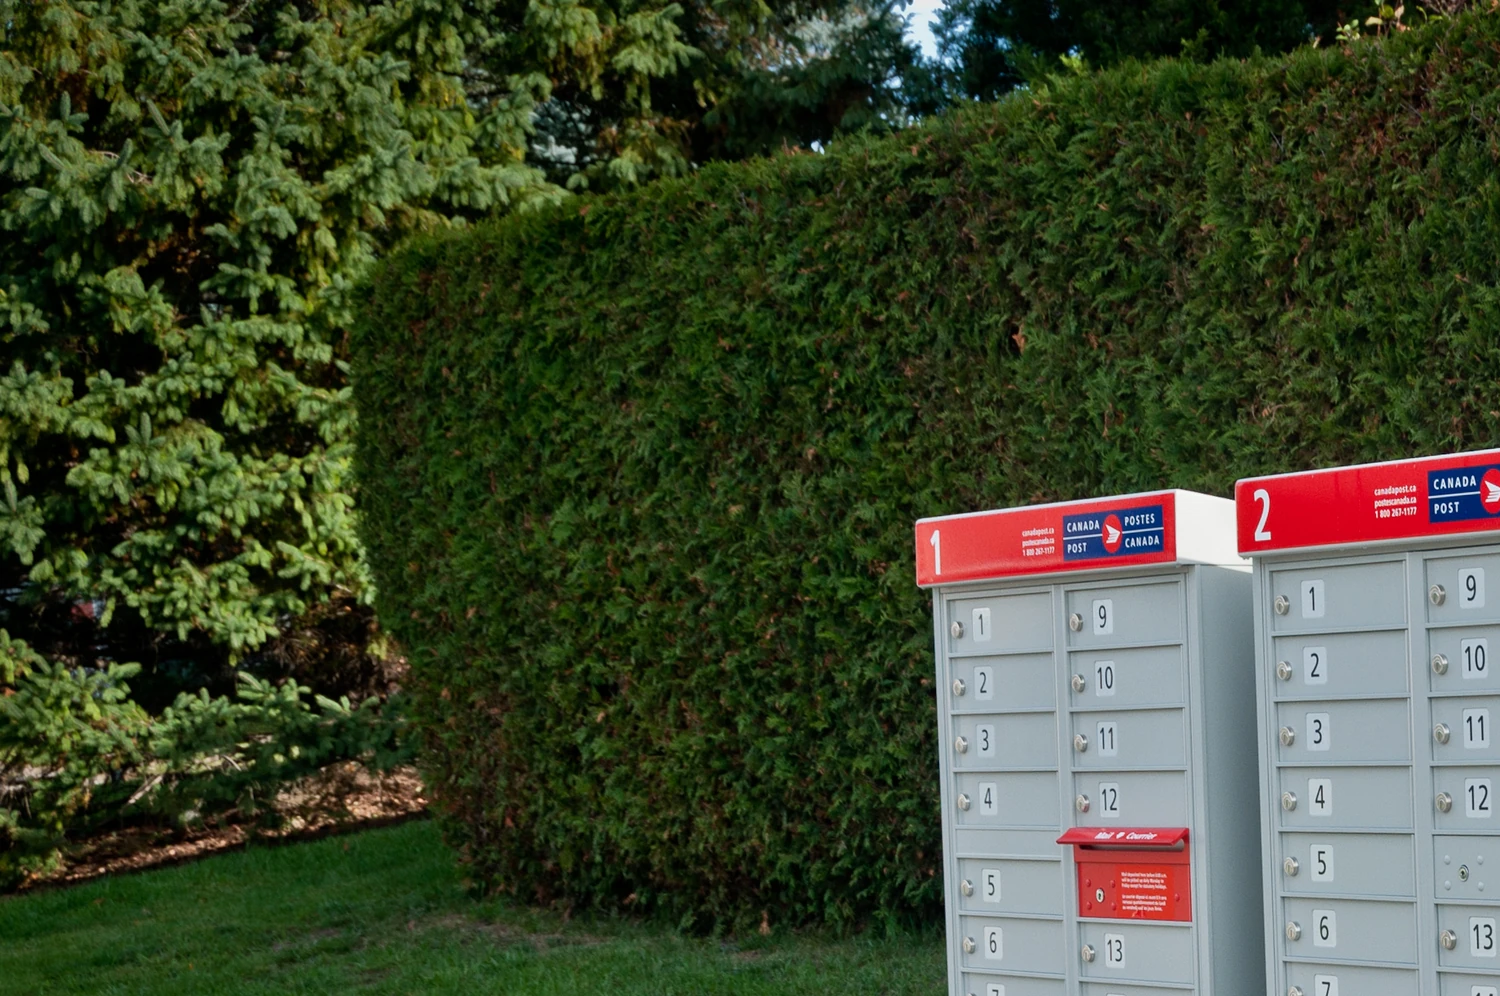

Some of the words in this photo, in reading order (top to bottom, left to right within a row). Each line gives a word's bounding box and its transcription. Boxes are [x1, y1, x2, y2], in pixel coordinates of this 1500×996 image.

[1374, 485, 1416, 496] canadapost.ca
[1434, 475, 1477, 490] CANADA
[1374, 496, 1416, 508] postescanada.ca
[1380, 510, 1390, 518] 800
[1392, 507, 1417, 517] 267-1177
[1434, 502, 1460, 514] POST
[1067, 520, 1100, 533] CANADA
[1125, 514, 1155, 526] POSTES
[1254, 488, 1271, 542] 2
[930, 529, 941, 576] 1
[1068, 543, 1087, 553] POST
[1125, 535, 1160, 548] CANADA
[1308, 586, 1316, 612] 1
[1465, 574, 1477, 602] 9
[977, 613, 984, 636] 1
[1098, 604, 1107, 629] 9
[1310, 652, 1320, 678] 2
[1464, 644, 1486, 672] 10
[979, 671, 988, 694] 2
[1097, 665, 1114, 690] 10
[981, 728, 990, 752] 3
[1099, 726, 1114, 750] 11
[1313, 719, 1323, 745] 3
[1466, 715, 1485, 742] 11
[983, 787, 993, 809] 4
[1101, 787, 1118, 811] 12
[1314, 784, 1326, 809] 4
[1468, 784, 1489, 811] 12
[1126, 832, 1157, 840] Courrier
[1317, 850, 1327, 876] 5
[987, 874, 996, 897] 5
[1319, 915, 1330, 941] 6
[1472, 923, 1494, 951] 13
[989, 931, 998, 954] 6
[1107, 939, 1123, 963] 13
